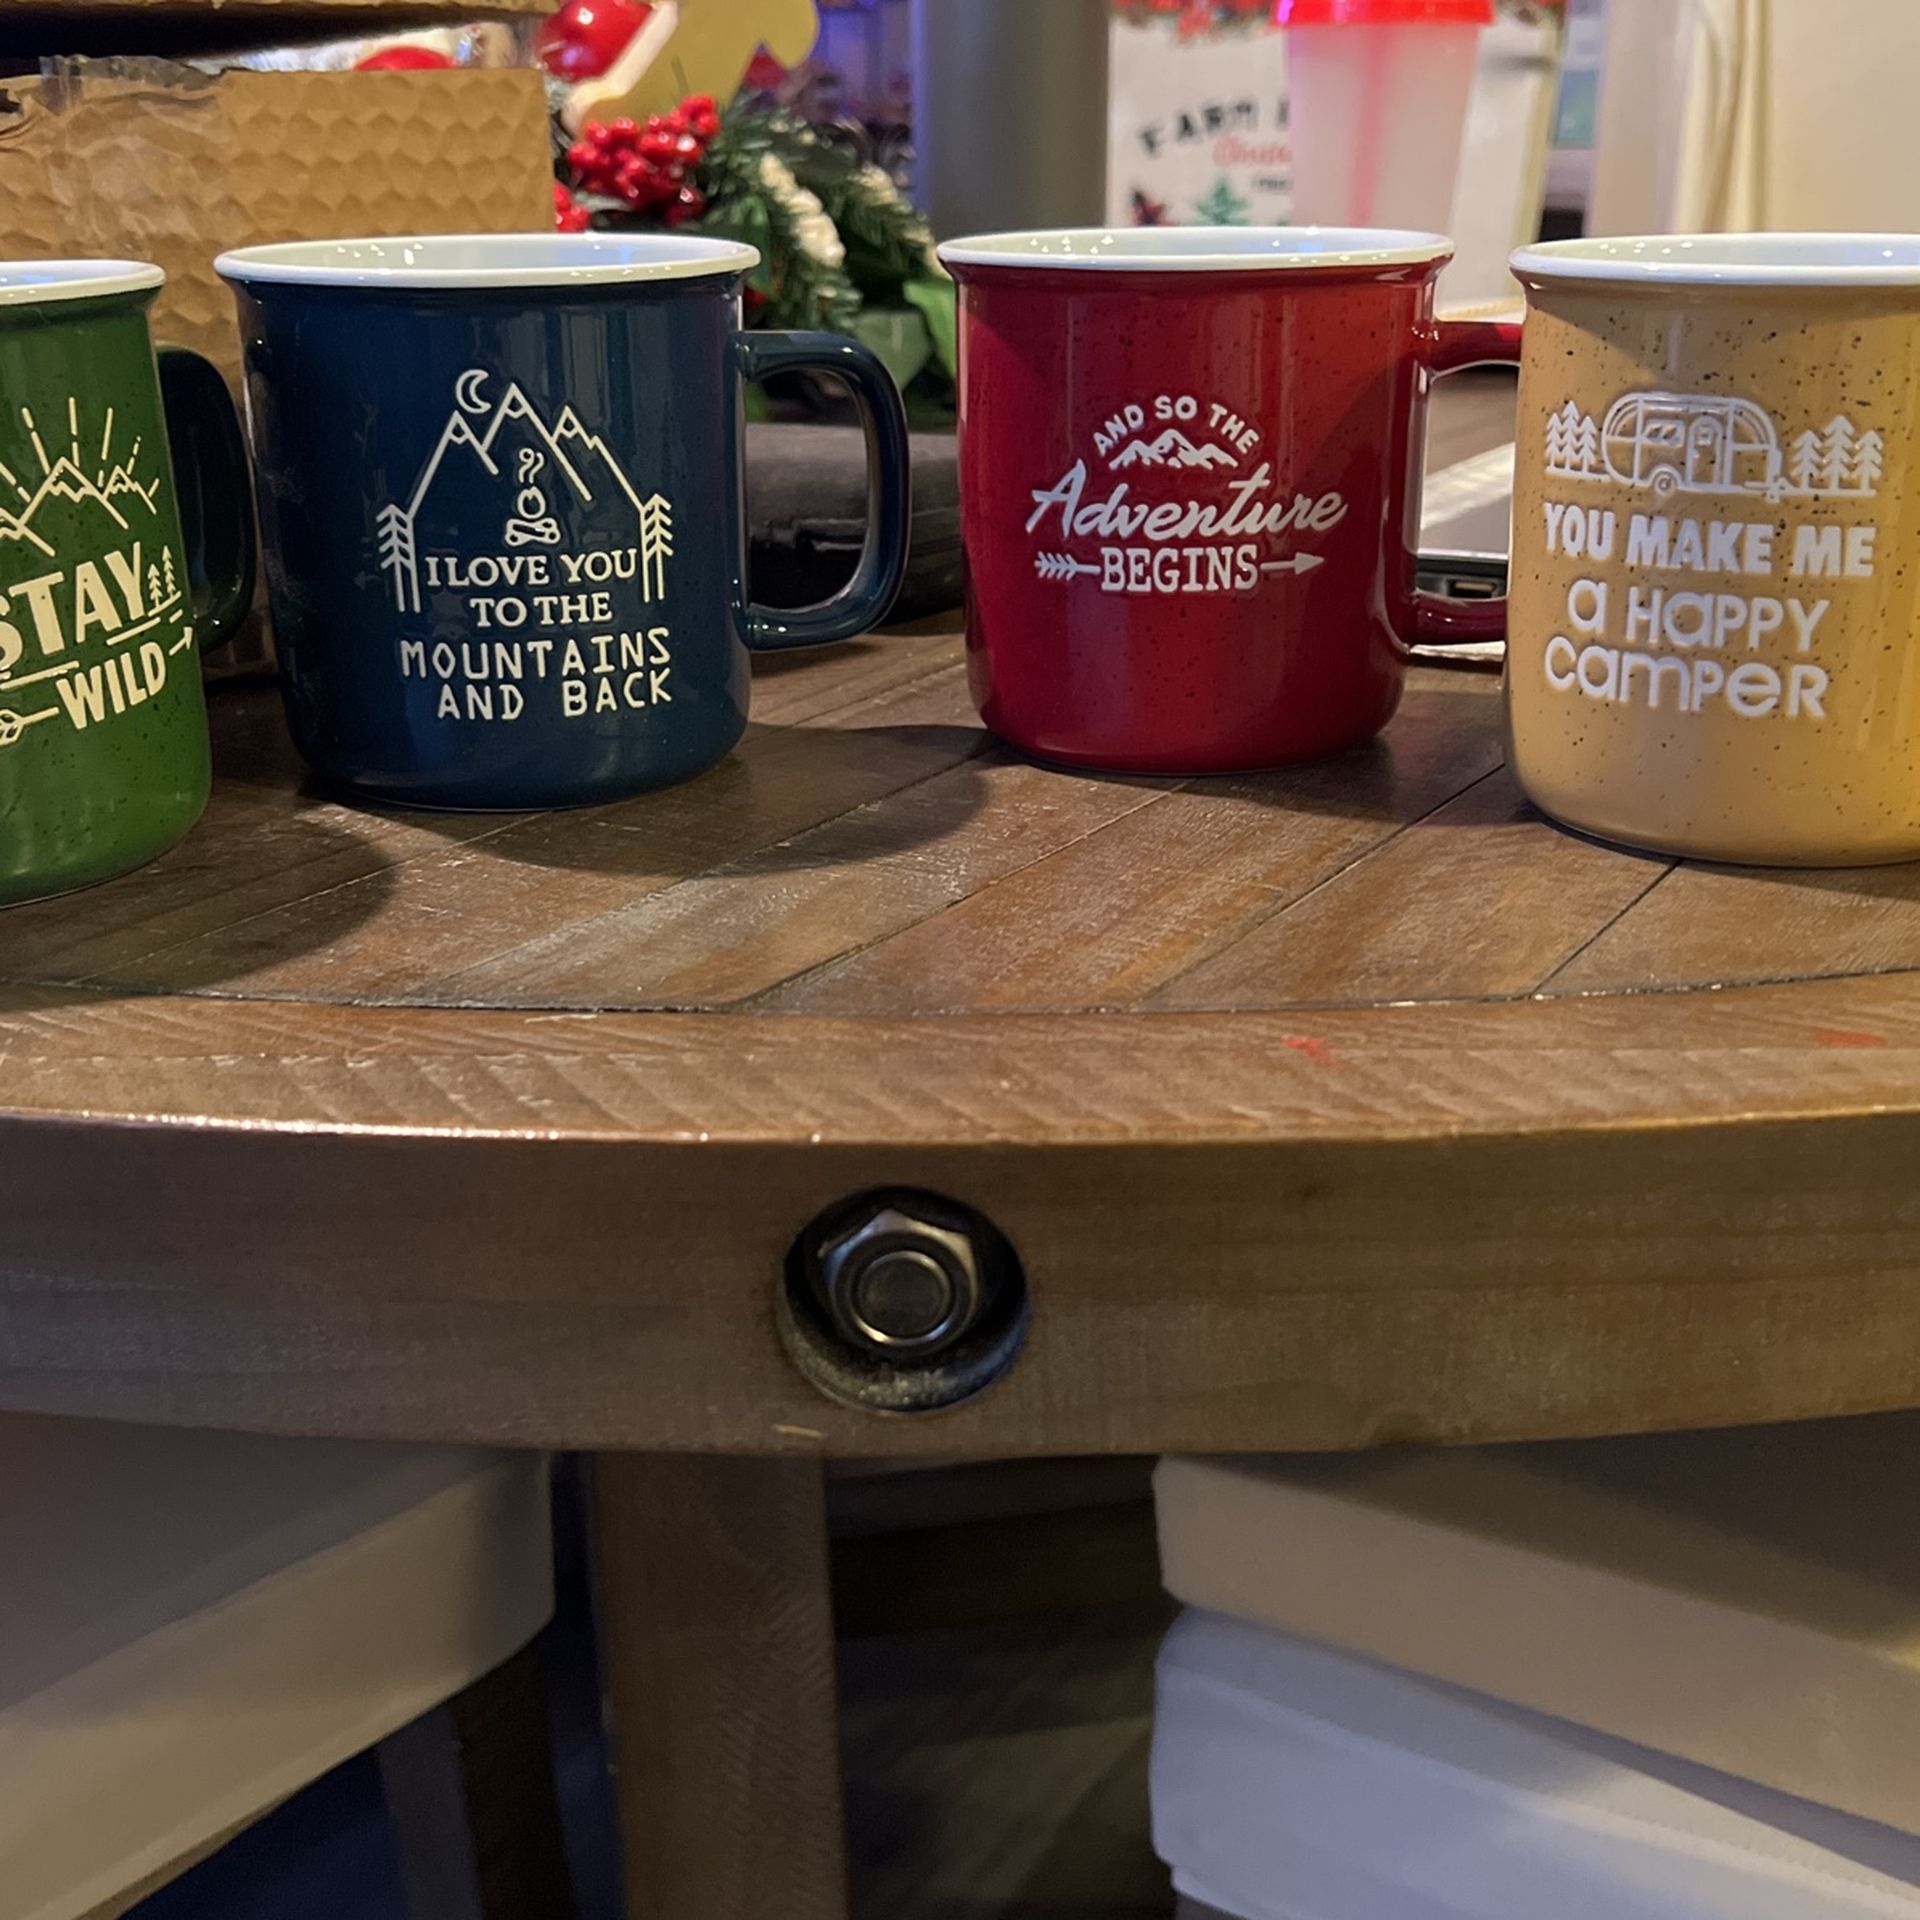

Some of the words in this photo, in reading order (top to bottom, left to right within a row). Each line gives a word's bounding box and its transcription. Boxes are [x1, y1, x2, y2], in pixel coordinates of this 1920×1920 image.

[1093, 404, 1144, 457] AND
[1155, 395, 1197, 420] SO
[1208, 403, 1260, 454] THE
[1025, 458, 1348, 541] Adventure
[1544, 501, 1615, 561] YOU
[1626, 514, 1774, 575] MAKE
[1790, 525, 1877, 577] ME
[425, 557, 441, 586] I
[445, 555, 549, 586] LOVE
[560, 548, 637, 583] YOU
[1100, 544, 1258, 592] BEGINS
[469, 597, 528, 627] TO
[533, 592, 613, 625] THE
[400, 626, 671, 680] MOUNTAINS
[56, 642, 166, 730] WILD
[437, 683, 524, 720] AND
[562, 667, 672, 717] BACK
